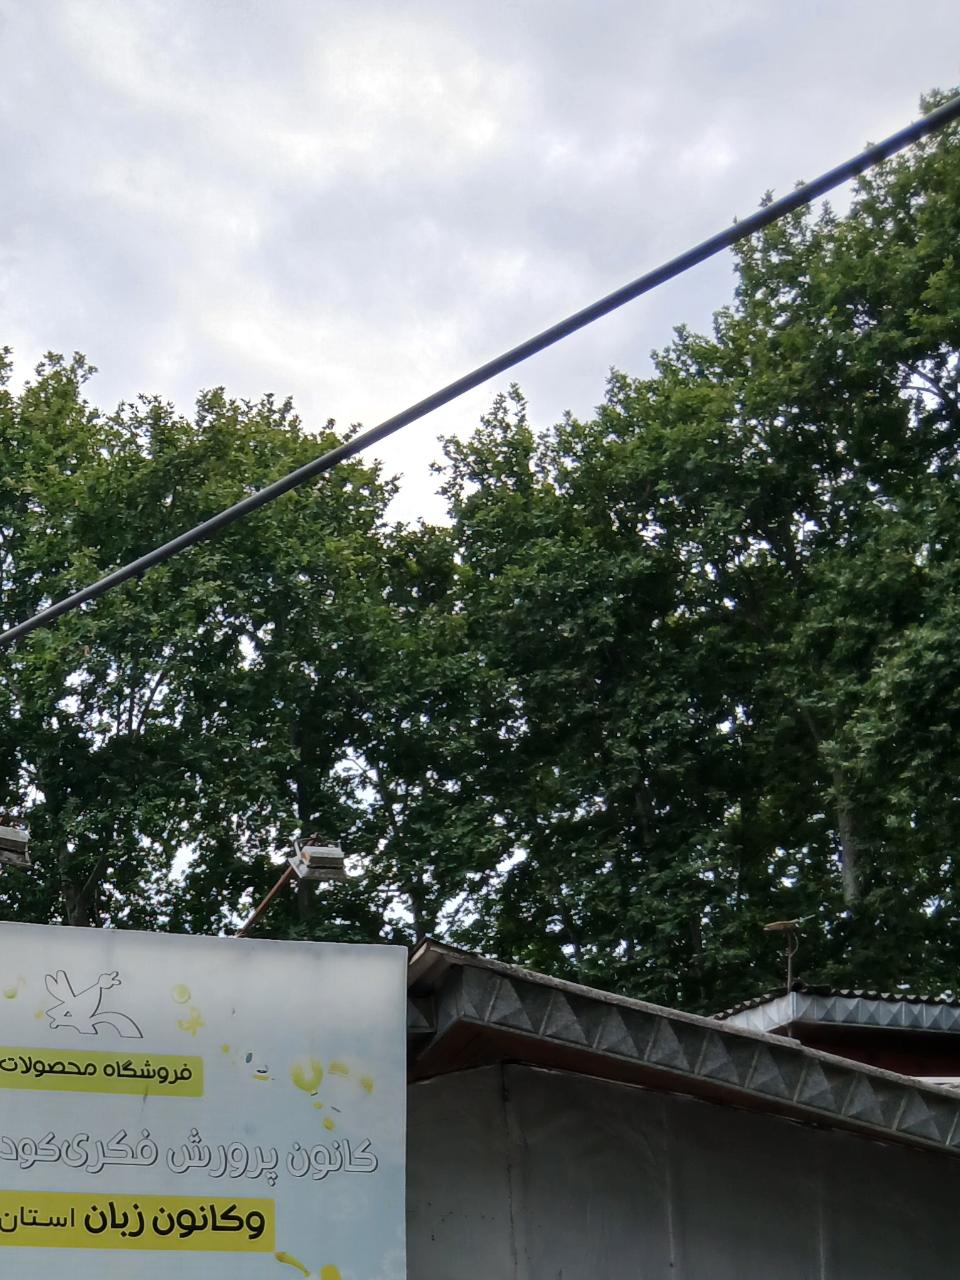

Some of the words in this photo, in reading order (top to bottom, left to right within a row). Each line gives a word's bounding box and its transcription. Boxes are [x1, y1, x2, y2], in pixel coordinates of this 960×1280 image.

[102, 1059, 193, 1085] فروشگاه
[61, 1128, 159, 1174] فکری
[166, 1127, 279, 1187] پرورش
[286, 1137, 379, 1181] کانون
[83, 1200, 146, 1239] زبان
